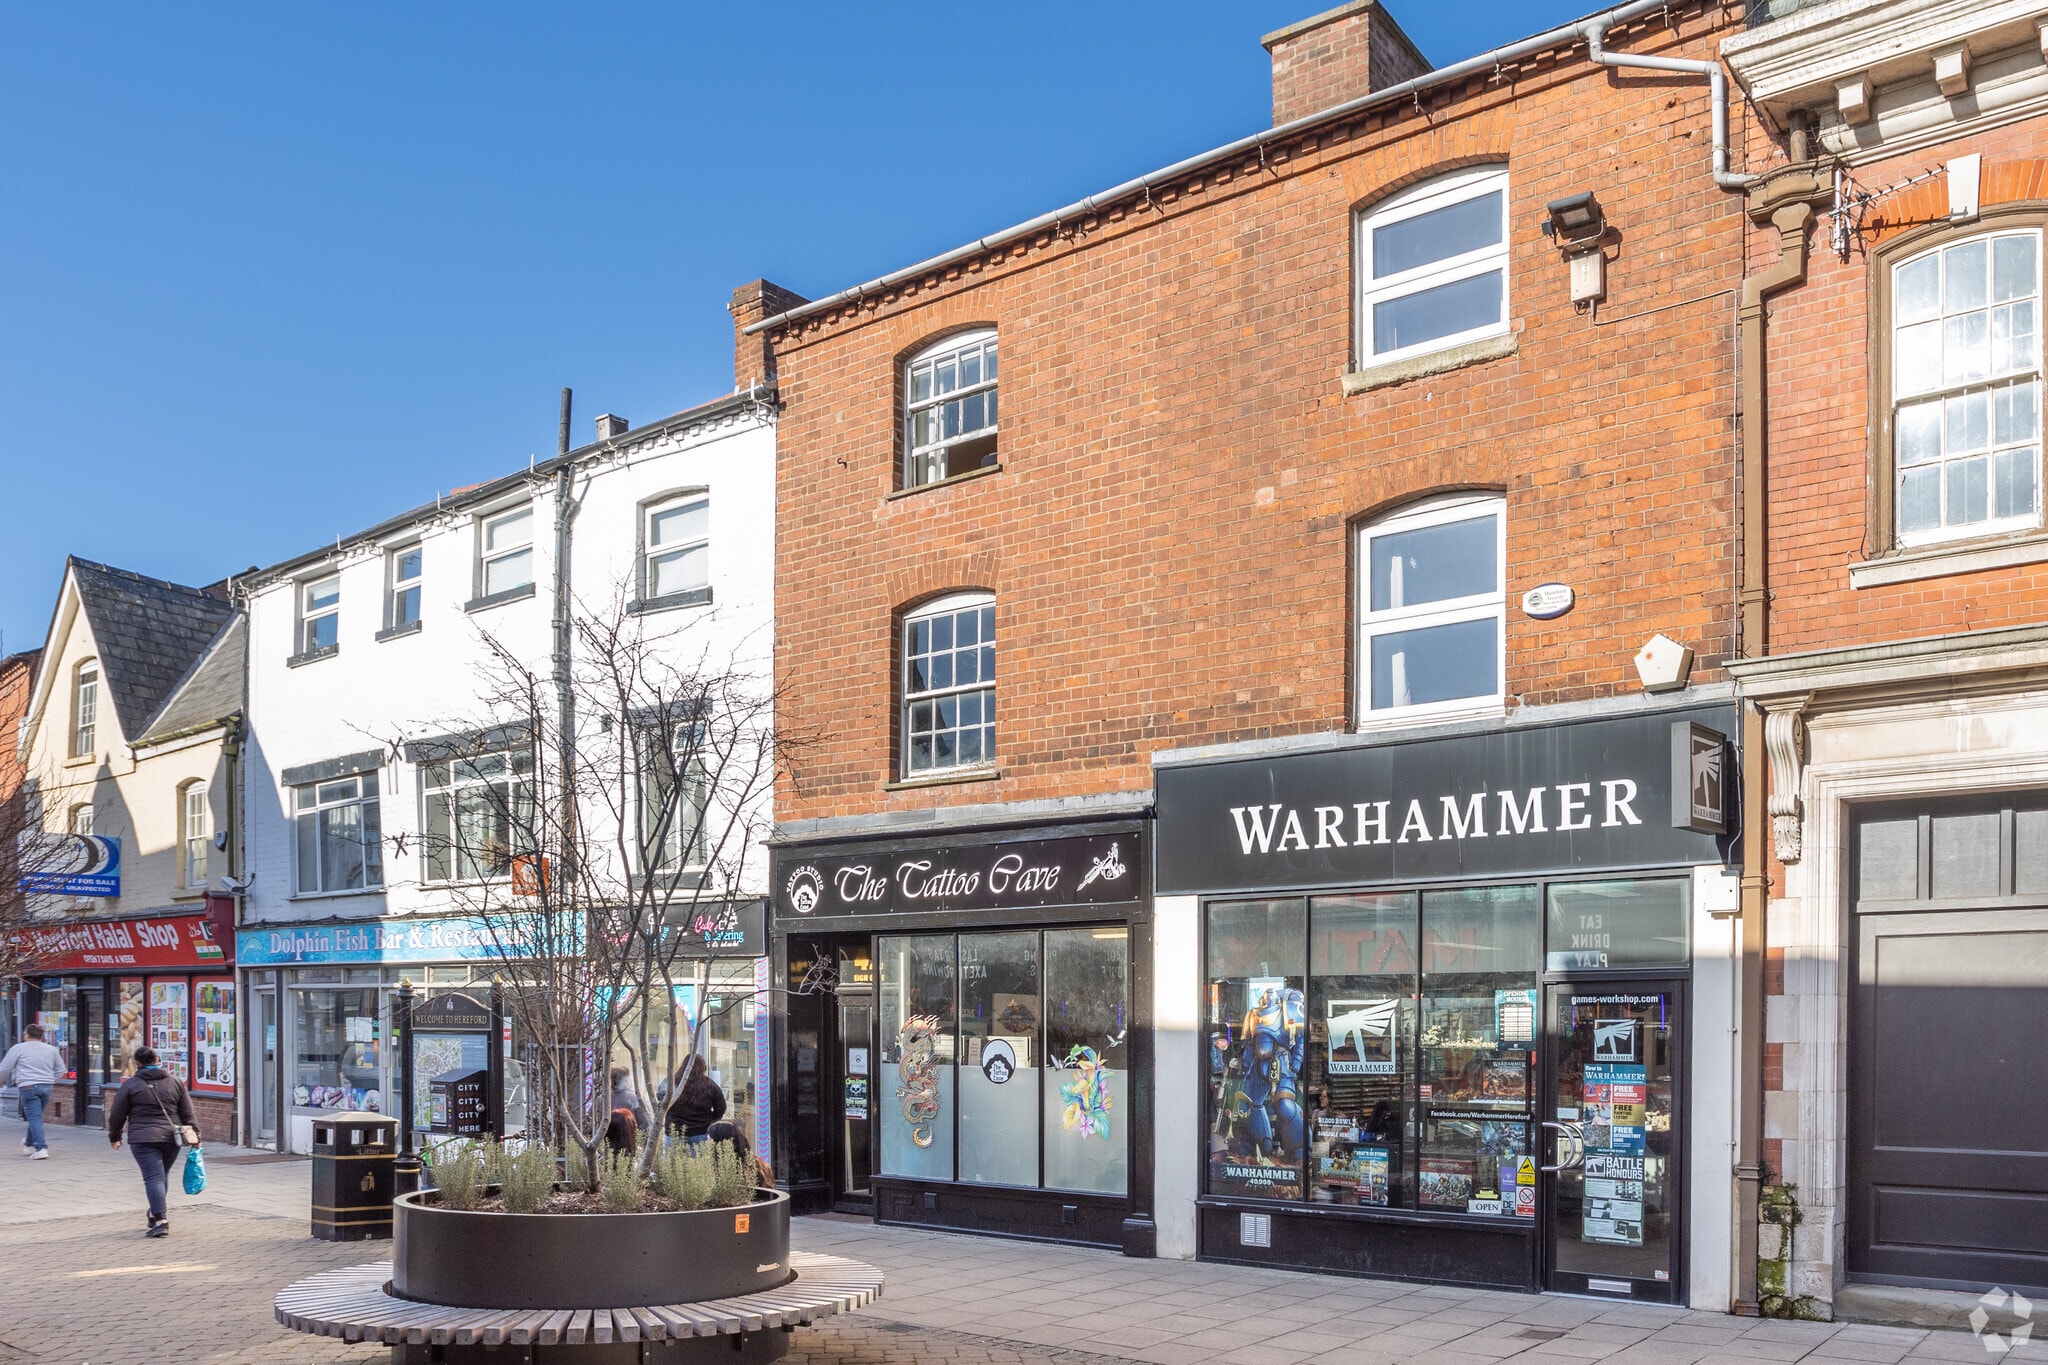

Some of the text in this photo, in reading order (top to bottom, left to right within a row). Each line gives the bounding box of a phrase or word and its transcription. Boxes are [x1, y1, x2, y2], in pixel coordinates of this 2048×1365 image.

[1230, 778, 1643, 855] WARHAMMER
[1694, 806, 1722, 822] WARHAMMER
[786, 866, 824, 893] TATTOO STUDIO
[834, 854, 1061, 901] The Tattoo Cave
[91, 922, 134, 950] Halal
[135, 920, 180, 950] Shop
[269, 930, 330, 961] Dolphin
[334, 927, 370, 951] Fish
[374, 926, 405, 950] Bar
[408, 925, 425, 949] &
[83, 954, 97, 963] OPEN
[102, 955, 115, 963] DAYS
[120, 954, 137, 963] WEEK
[1571, 994, 1659, 1005] games-workshop.com
[415, 1014, 487, 1025] WELCOME TO HEREFORD
[1330, 1063, 1394, 1073] WARHAMMER
[1585, 1072, 1646, 1080] WARHAMMER!
[458, 1083, 480, 1091] CITY
[1430, 1110, 1531, 1121] Facebook.com/WarhammerHereford
[359, 1147, 382, 1155] Litter
[1606, 1156, 1643, 1170] BATTLE
[1226, 1167, 1296, 1181] WARHAMMER
[1606, 1167, 1643, 1180] HONOURS
[1475, 1203, 1499, 1211] OPEN
